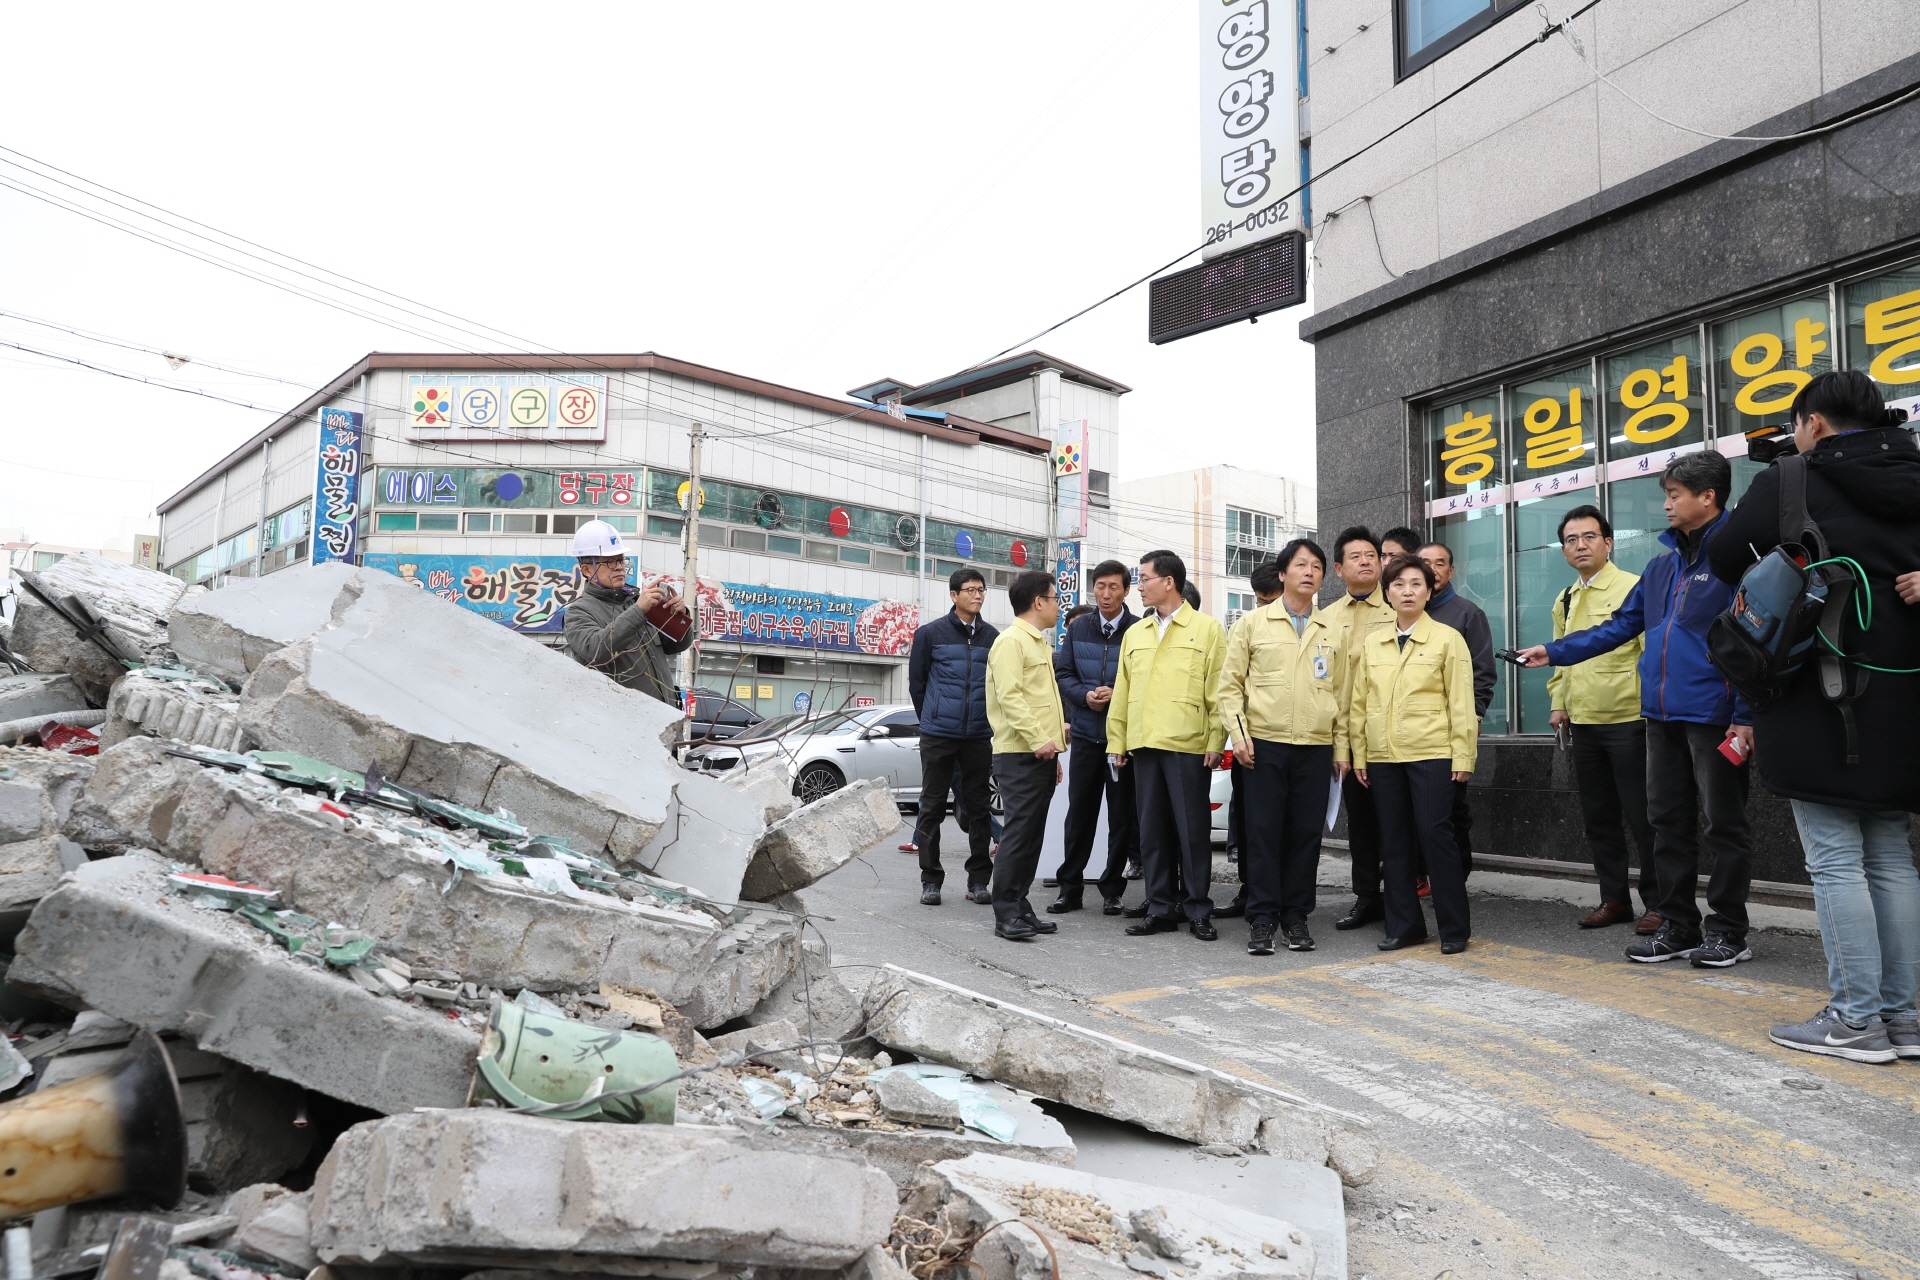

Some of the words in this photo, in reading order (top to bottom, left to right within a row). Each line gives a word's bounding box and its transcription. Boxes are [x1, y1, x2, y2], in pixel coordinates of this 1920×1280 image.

[1217, 0, 1276, 209] 영양탕
[1206, 201, 1289, 246] 261-0032
[467, 393, 594, 423] 당구장
[327, 414, 358, 446] 바다
[319, 446, 356, 555] 해물찜
[386, 471, 457, 503] 에이스
[559, 472, 635, 505] 당구장
[463, 563, 583, 625] 해물찜
[723, 588, 778, 607] 청정바다의
[781, 596, 822, 613] 싱싱함을
[854, 623, 880, 648] 전문
